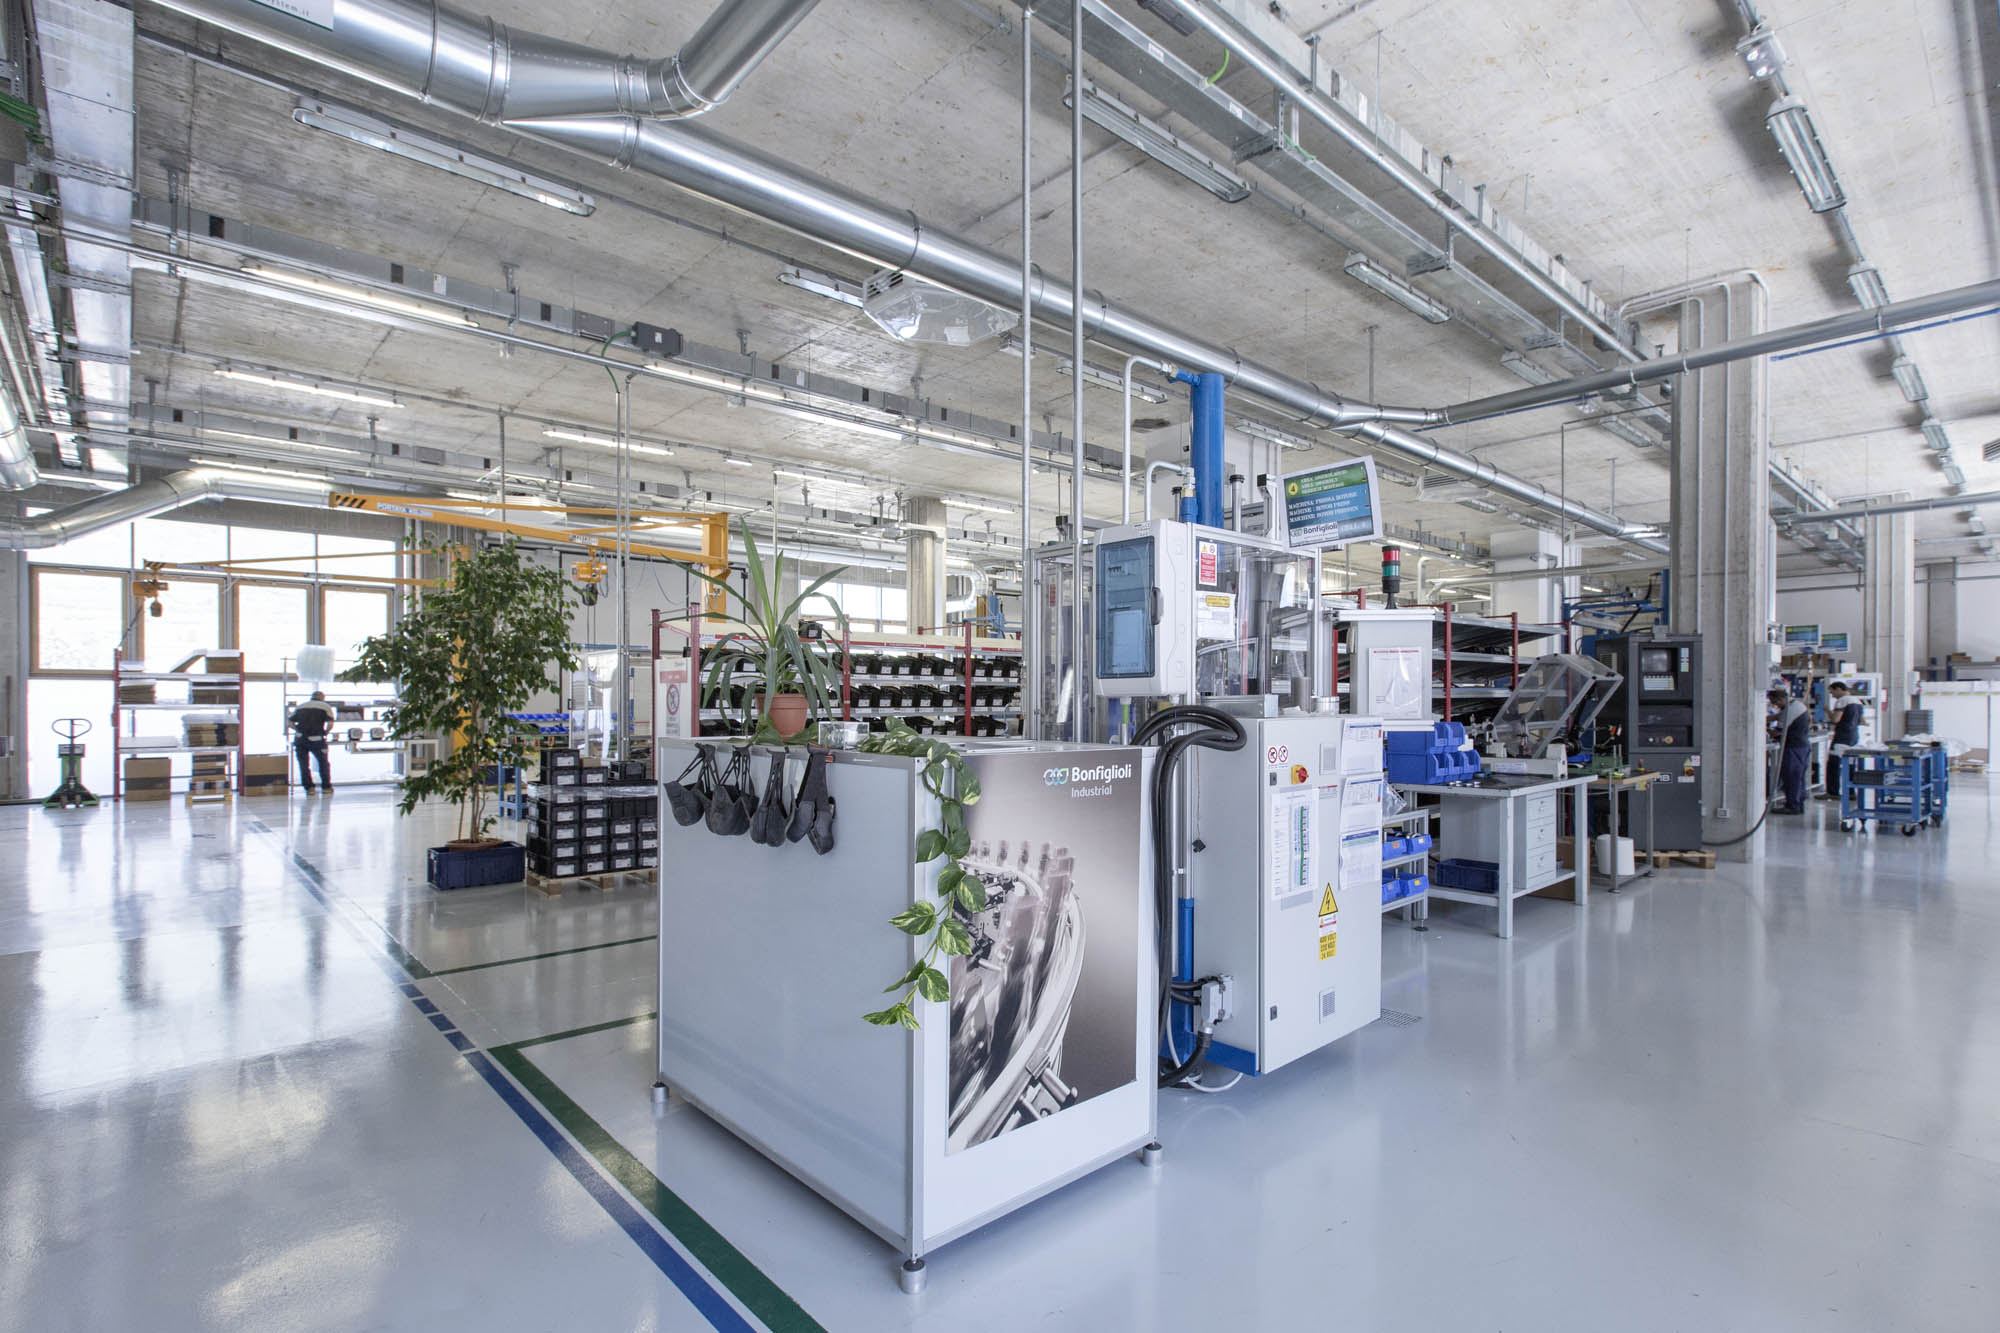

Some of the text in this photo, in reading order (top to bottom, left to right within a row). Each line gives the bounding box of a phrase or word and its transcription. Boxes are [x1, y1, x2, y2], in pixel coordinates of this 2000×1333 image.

[1303, 522, 1338, 535] Bonfiglioli
[1071, 764, 1132, 783] Bonfiglioli
[1071, 785, 1112, 798] Industrial
